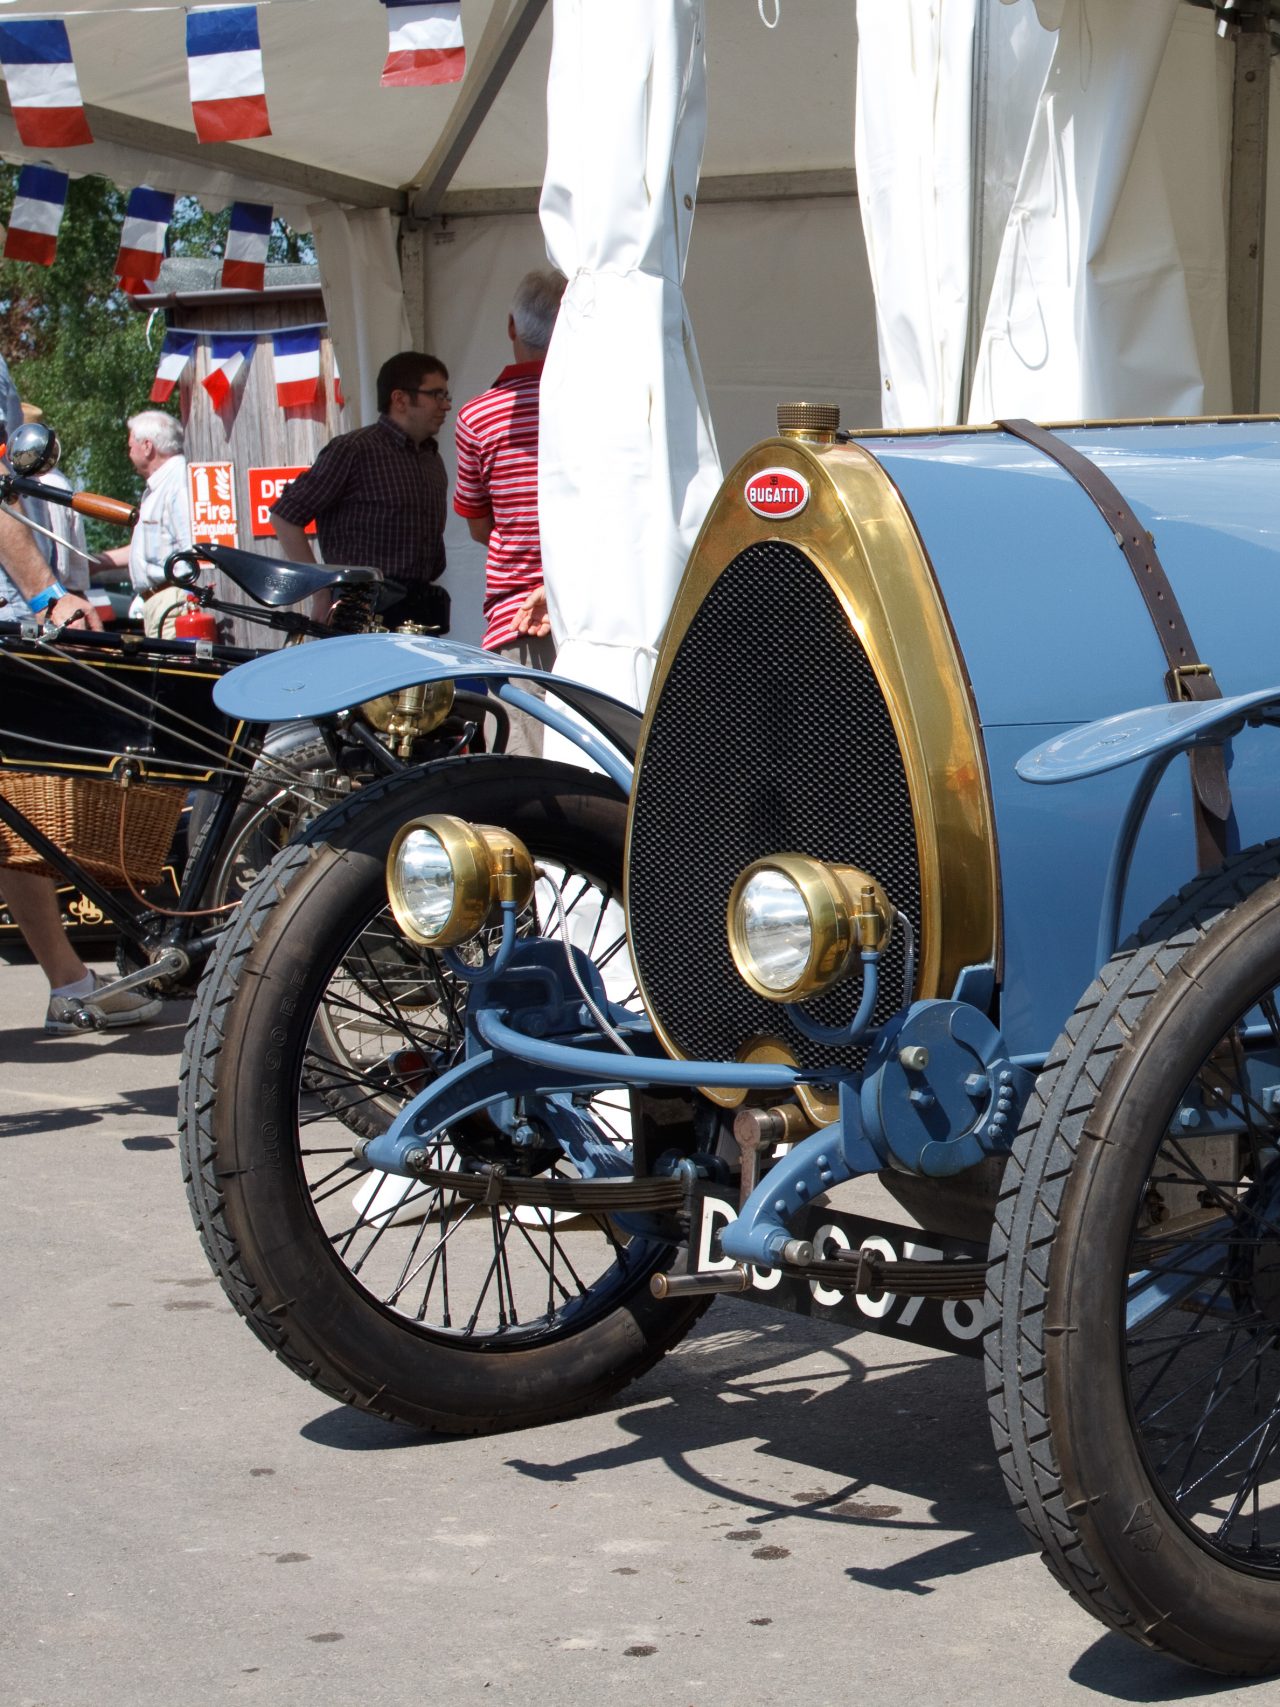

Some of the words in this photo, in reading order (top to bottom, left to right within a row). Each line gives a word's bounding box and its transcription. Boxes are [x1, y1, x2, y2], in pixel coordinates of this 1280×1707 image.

[261, 478, 296, 498] DE
[749, 487, 799, 503] BUGATTI
[195, 500, 231, 521] Fire
[192, 521, 237, 538] Extinguisher
